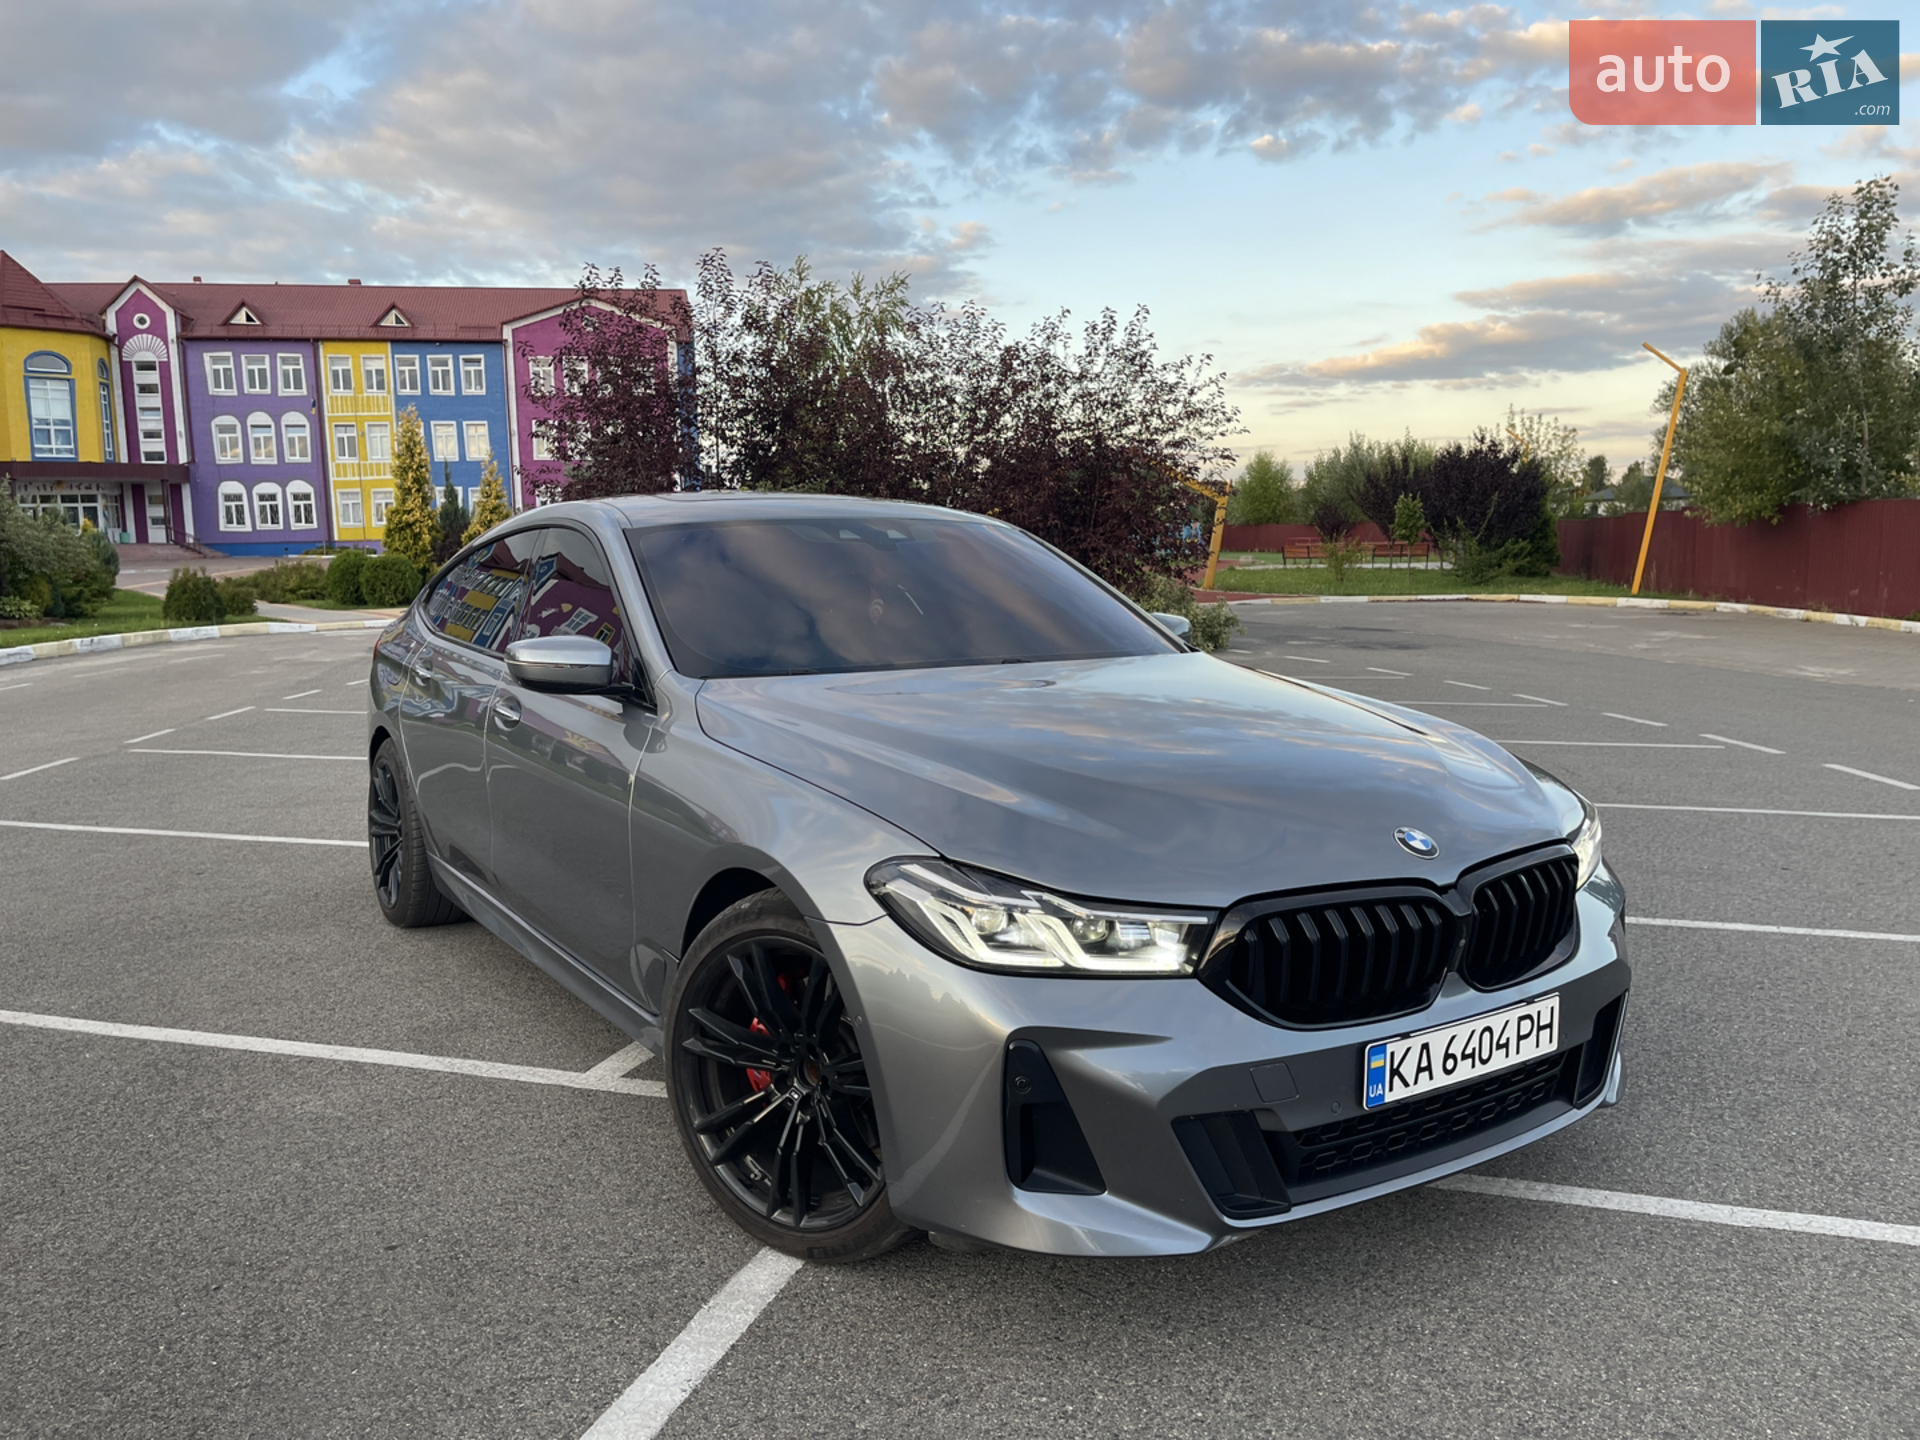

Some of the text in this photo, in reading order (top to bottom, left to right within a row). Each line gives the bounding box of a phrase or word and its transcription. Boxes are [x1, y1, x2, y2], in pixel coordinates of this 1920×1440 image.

[1388, 1006, 1555, 1092] KA 6404 PH
[1368, 1083, 1384, 1098] UA
